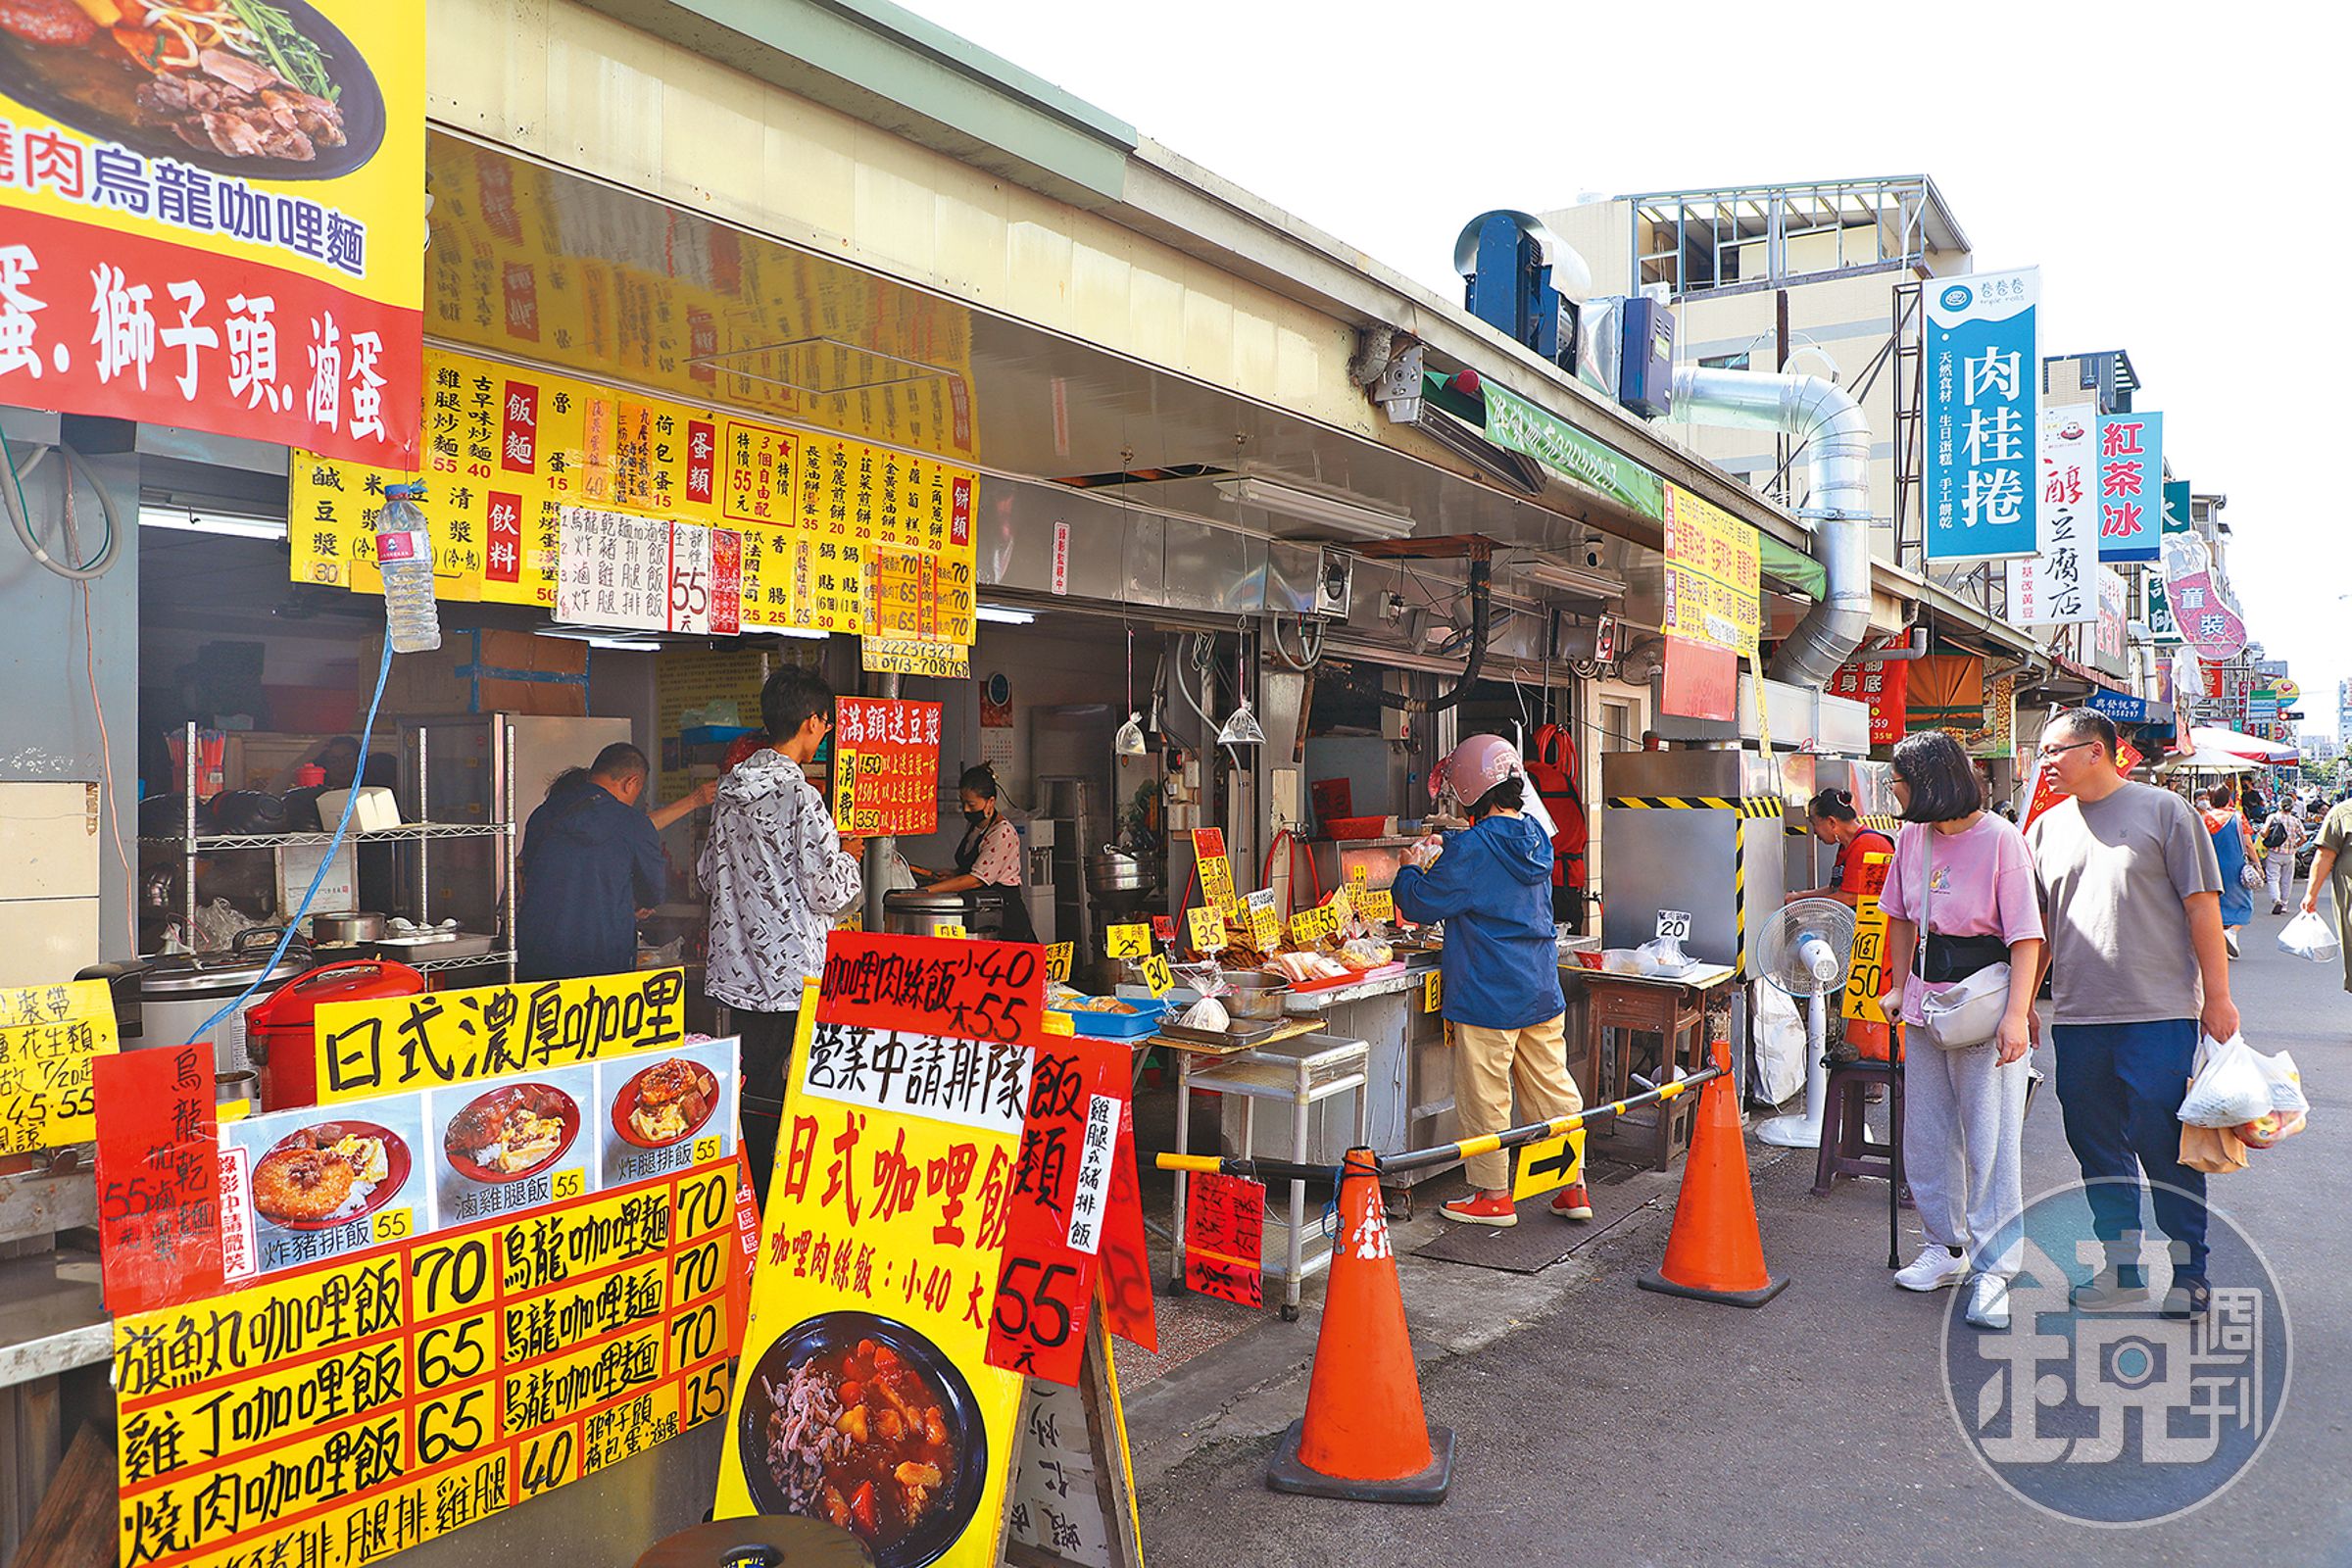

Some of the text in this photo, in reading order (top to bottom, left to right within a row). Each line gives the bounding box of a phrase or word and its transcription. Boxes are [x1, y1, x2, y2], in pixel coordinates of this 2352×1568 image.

[433, 368, 462, 473] 雞腿炒麵 55
[466, 375, 495, 479] 古早味炒麵 40
[506, 393, 535, 466] 飯麵
[547, 392, 572, 491] 魯蛋 15
[1961, 345, 2025, 527] 肉桂捲
[654, 415, 674, 508] 荷包蛋 15
[690, 432, 713, 496] 蛋類
[755, 437, 772, 517] 3個自由配
[777, 463, 790, 497] 特價
[2101, 421, 2144, 538] 紅茶冰
[449, 487, 474, 543] 清漿
[830, 452, 848, 535] 高麗煎餅 20
[954, 486, 969, 539] 餅類
[313, 466, 345, 583] 鹹豆漿 30
[489, 503, 519, 573] 飲料
[803, 518, 818, 530] 35
[856, 527, 870, 539] 20
[881, 531, 896, 543] 20
[906, 535, 919, 546] 20
[928, 540, 942, 551] 20
[743, 544, 761, 603] 法國吐司
[768, 535, 787, 623] 香腸 25
[818, 542, 837, 590] 鍋貼
[842, 546, 859, 594] 鍋貼
[901, 554, 918, 575] 70
[952, 562, 969, 584] 70
[672, 566, 708, 615] 55
[743, 609, 760, 621] 25
[900, 582, 917, 603] 65
[952, 590, 969, 611] 70
[2180, 588, 2226, 637] 童裝
[680, 615, 693, 632] 元
[796, 609, 810, 625] 25
[818, 616, 834, 628] 30
[849, 618, 857, 629] 6
[898, 612, 916, 632] 65
[952, 617, 969, 637] 70
[882, 640, 955, 660] 22237329
[882, 656, 970, 678] 0913-708768
[841, 703, 941, 746] 滿額送豆漿
[839, 755, 856, 826] 消費
[1198, 923, 1220, 947] 35
[1319, 906, 1339, 932] 55
[1660, 921, 1685, 937] 20
[1118, 940, 1140, 956] 25
[819, 949, 956, 1013] 咖哩肉絲飯
[1148, 956, 1169, 991] 30
[326, 969, 685, 1092] 日式濃厚咖哩
[808, 1023, 1035, 1122] 營業中請排隊
[172, 1048, 215, 1236] 烏龍乾麵
[1014, 1054, 1083, 1213] 飯類
[617, 1140, 716, 1182] 炸腿排飯 55
[105, 1177, 150, 1222] 55
[218, 1152, 245, 1273] 錄影中請微笑
[454, 1172, 580, 1222] 滷雞腿飯 55
[263, 1210, 407, 1269] 炸豬排飯 55
[118, 1174, 726, 1395] 旗魚丸咖哩飯 70 烏龍咖哩麵 70
[962, 1270, 985, 1331] 大
[995, 1258, 1077, 1348] 55
[123, 1240, 719, 1481] 雞丁咖哩飯 65 烏龍咖哩麵 70
[687, 1362, 726, 1426] 15
[123, 1303, 717, 1567] 燒肉咖哩飯 65 烏龍咖哩麵 70
[521, 1430, 571, 1494] 40
